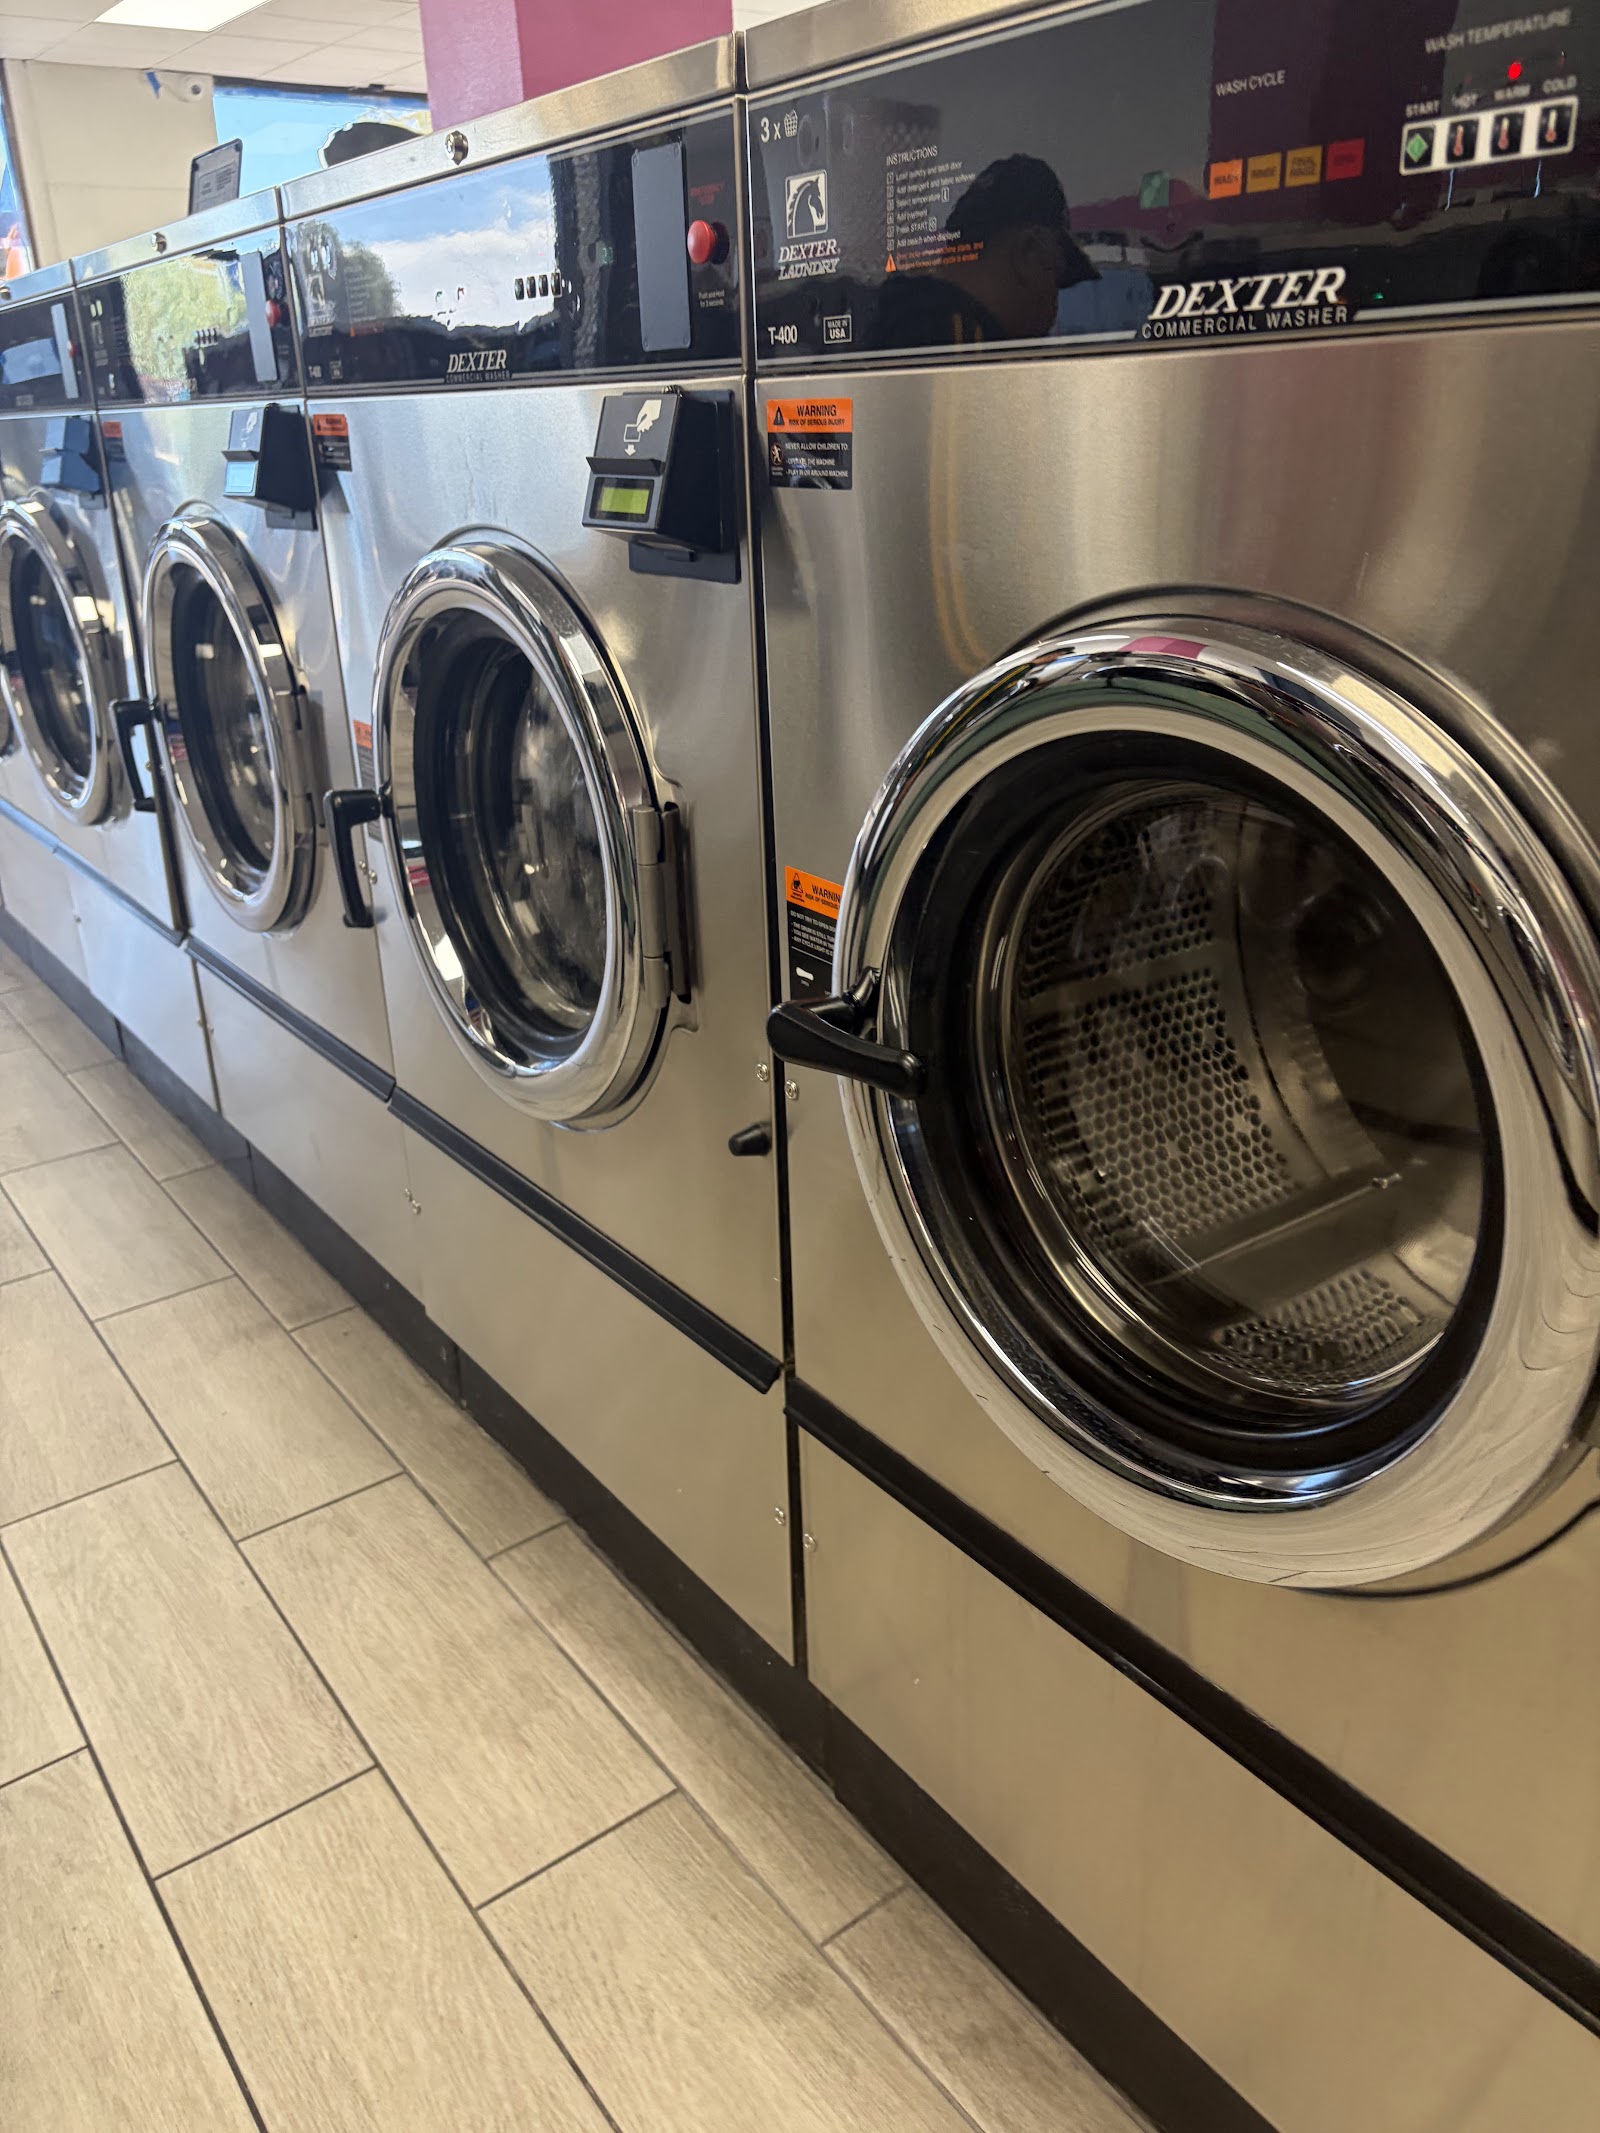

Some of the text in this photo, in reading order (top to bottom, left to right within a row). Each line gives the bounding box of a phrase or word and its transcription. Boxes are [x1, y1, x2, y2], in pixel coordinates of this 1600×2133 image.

[1425, 8, 1572, 53] WASH TEMPERATURE
[1216, 69, 1286, 97] WASH CYCLE
[1542, 75, 1577, 95] COLD
[1405, 99, 1440, 118] START
[760, 116, 770, 143] 3
[886, 145, 938, 166] INSTRUCTIONS
[911, 221, 928, 232] START
[778, 239, 837, 263] DEXTER
[778, 258, 841, 280] LAUNDRY
[1147, 266, 1346, 320] DEXTER
[827, 320, 841, 328] MADE
[1141, 305, 1348, 339] COMMERCIAL WASHER
[768, 324, 798, 345] T-400
[829, 328, 846, 339] USA
[447, 349, 507, 373] DEXTER
[797, 405, 836, 417] WARNING
[817, 443, 840, 451] CHILDREN
[812, 884, 841, 903] WARNIN
